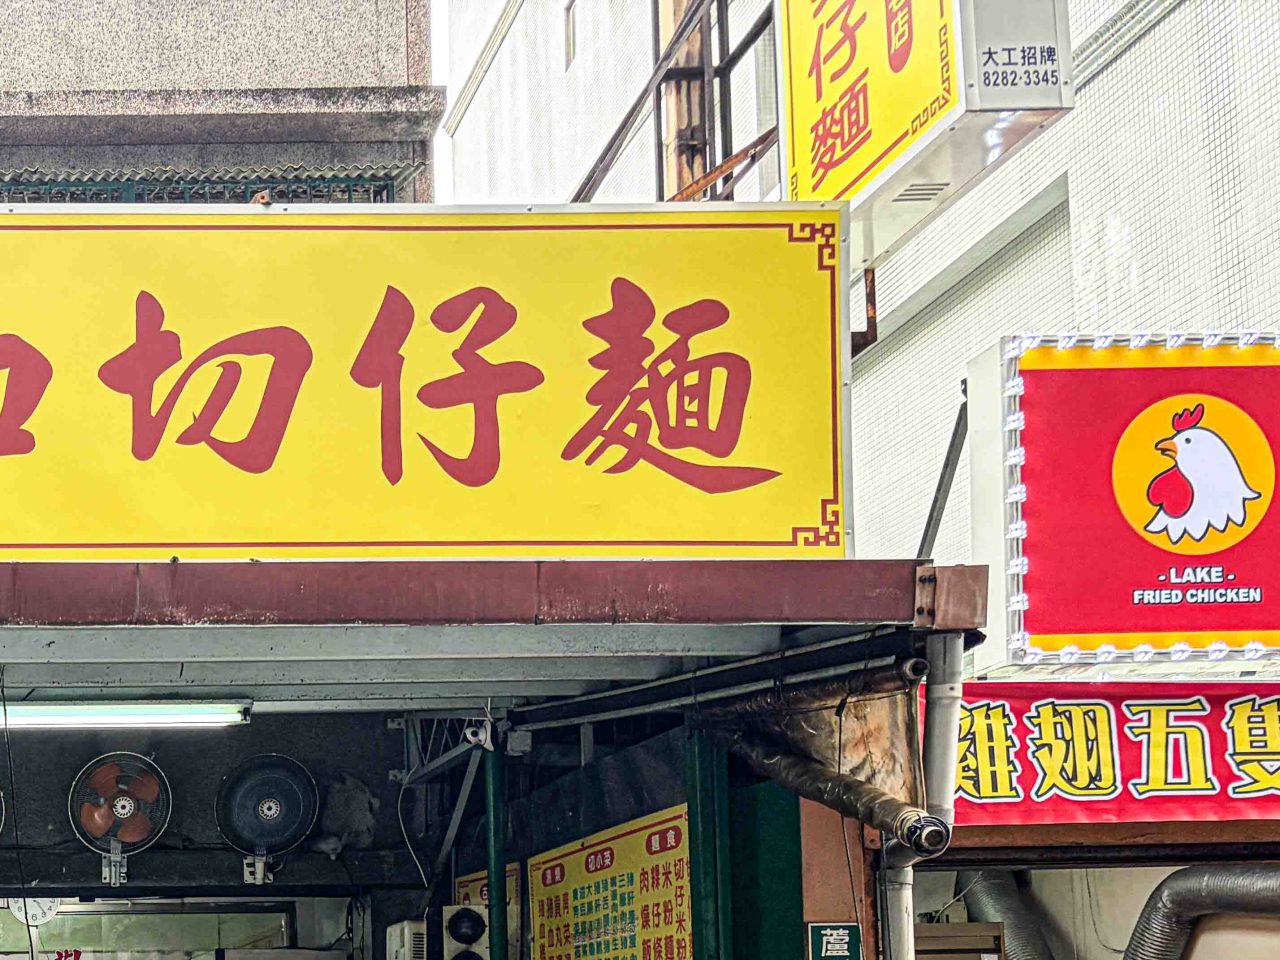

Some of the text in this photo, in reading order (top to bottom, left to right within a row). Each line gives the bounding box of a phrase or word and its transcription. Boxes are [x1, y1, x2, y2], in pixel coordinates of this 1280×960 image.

[889, 0, 910, 50] 店
[982, 46, 1057, 67] 大工招牌
[807, 0, 872, 193] 仔麵
[1170, 566, 1224, 583] LAKE
[1133, 587, 1261, 604] FRIED CHICKEN
